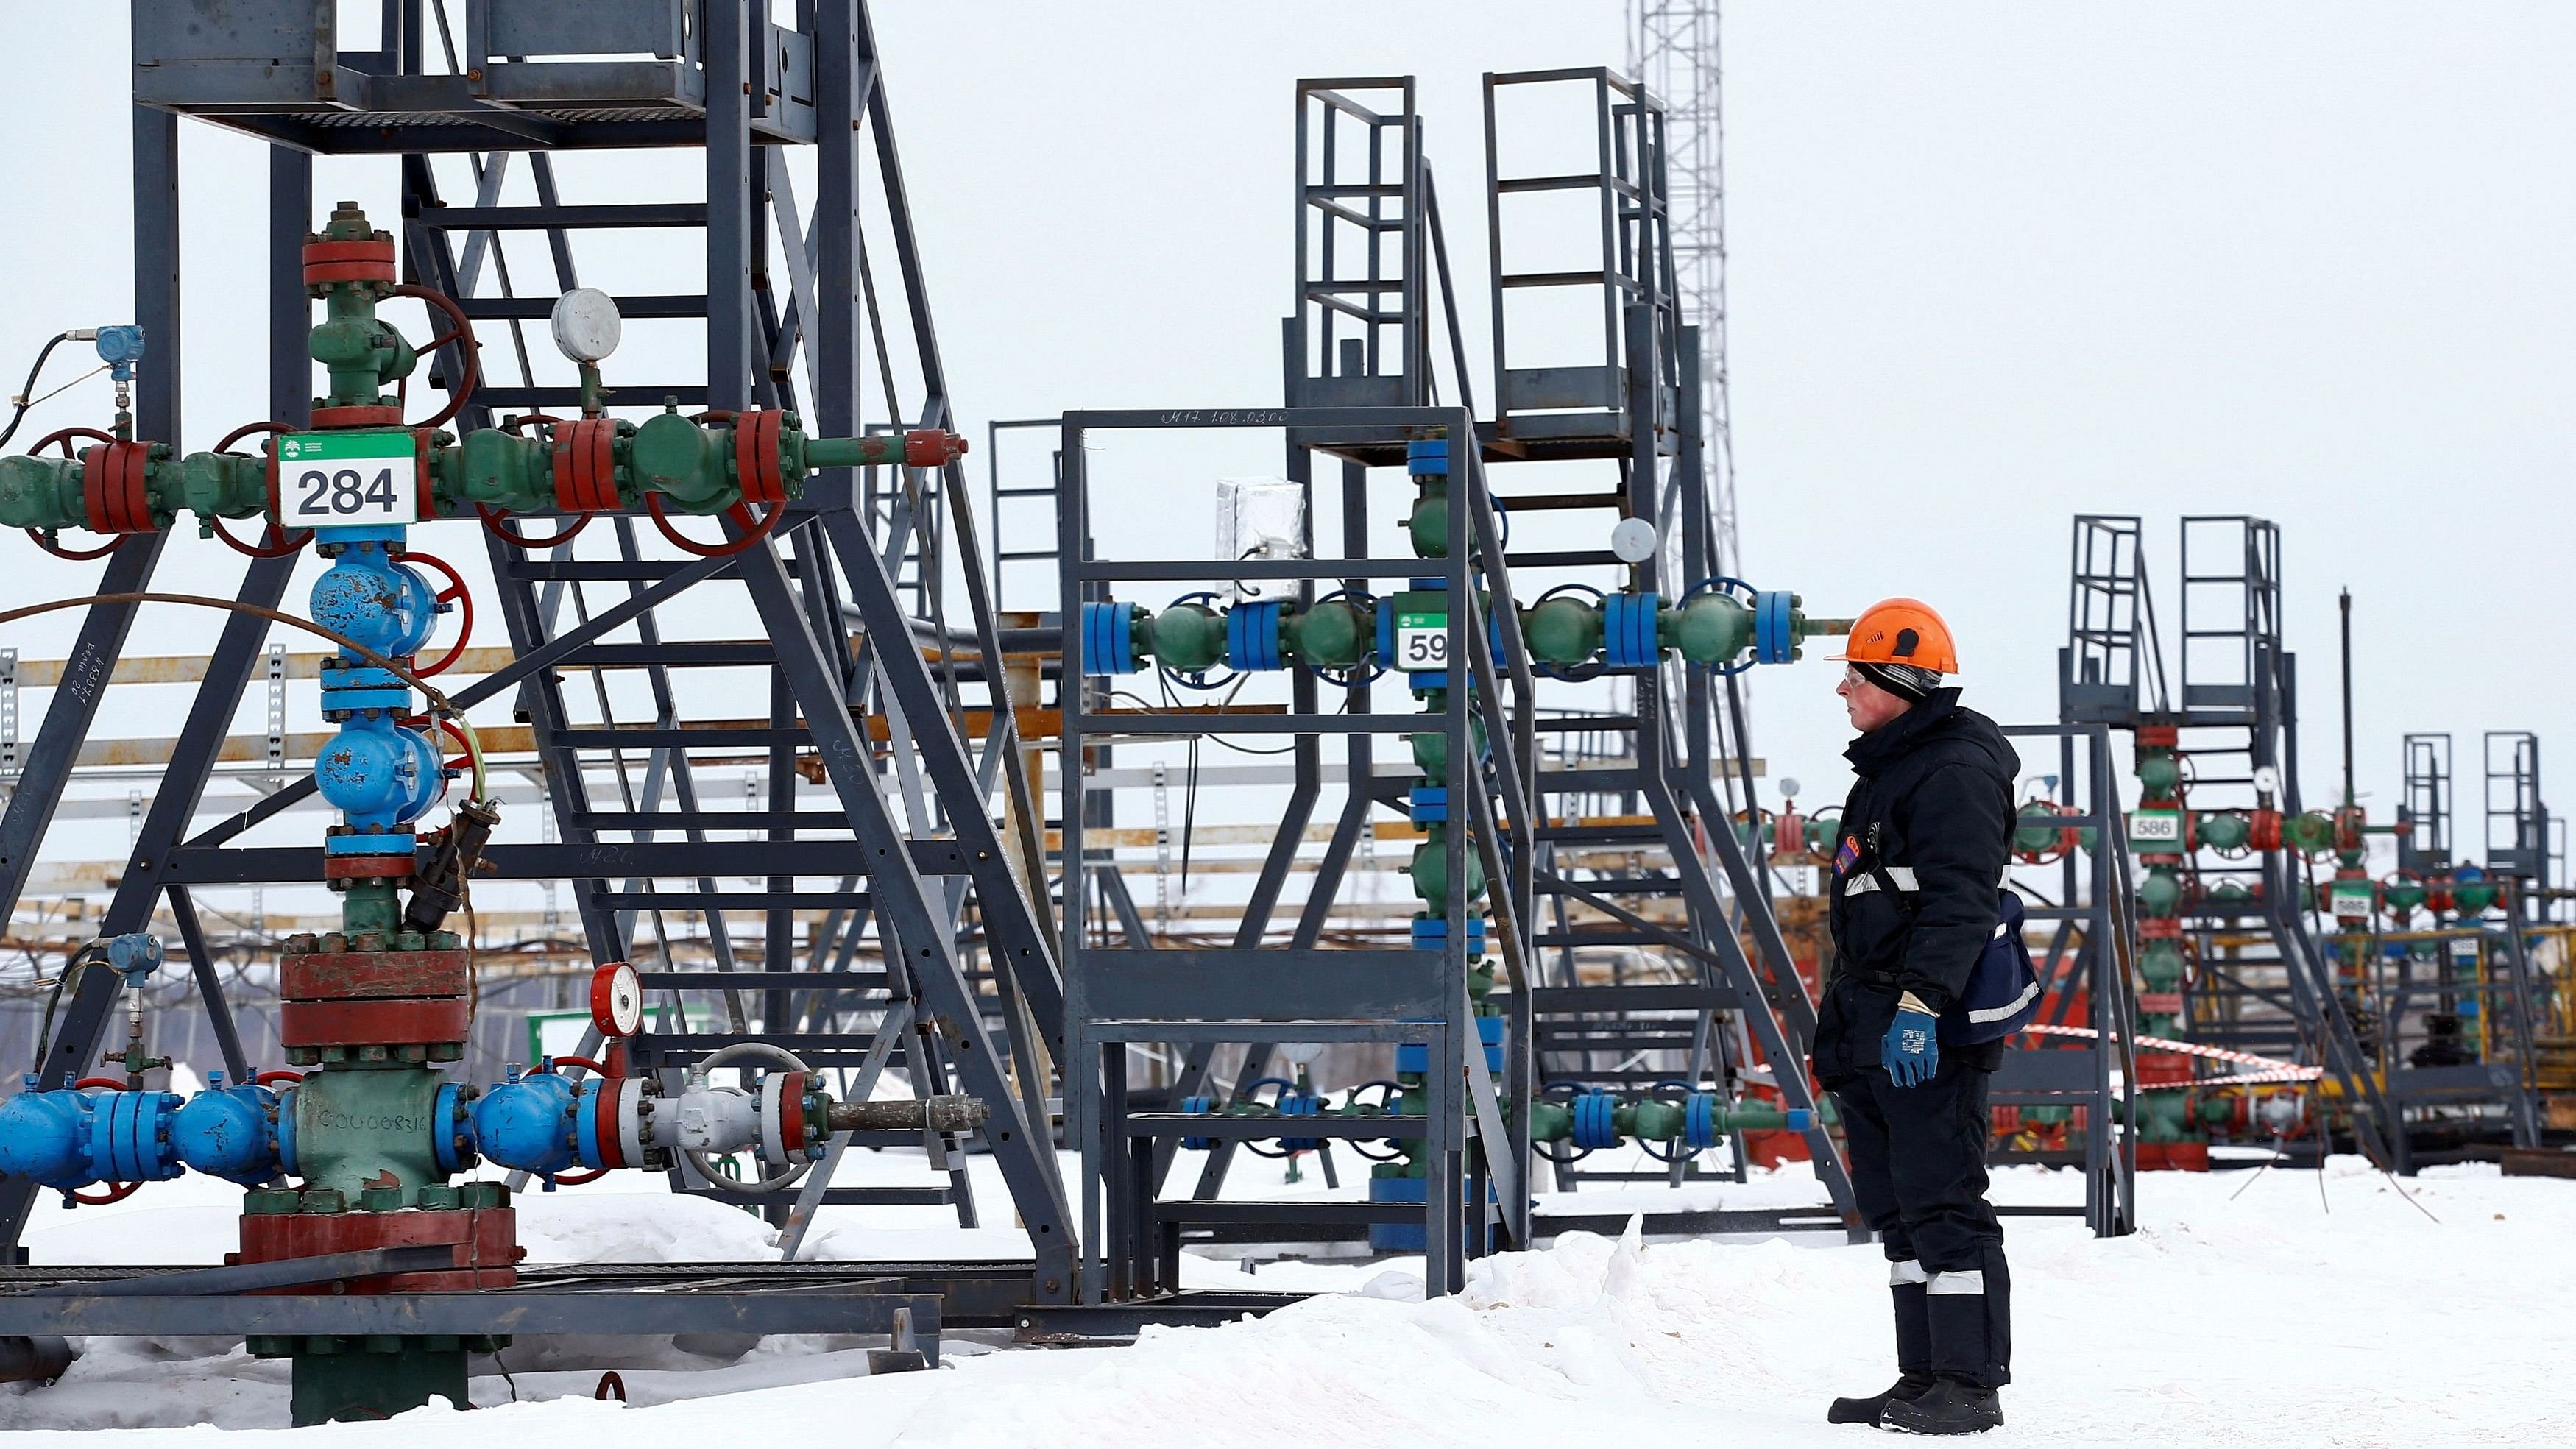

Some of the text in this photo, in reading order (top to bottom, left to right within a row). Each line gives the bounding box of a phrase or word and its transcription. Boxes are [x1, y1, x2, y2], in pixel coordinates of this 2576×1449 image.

[298, 468, 397, 515] 284
[1409, 634, 1447, 662] 59
[2137, 820, 2171, 837] 586
